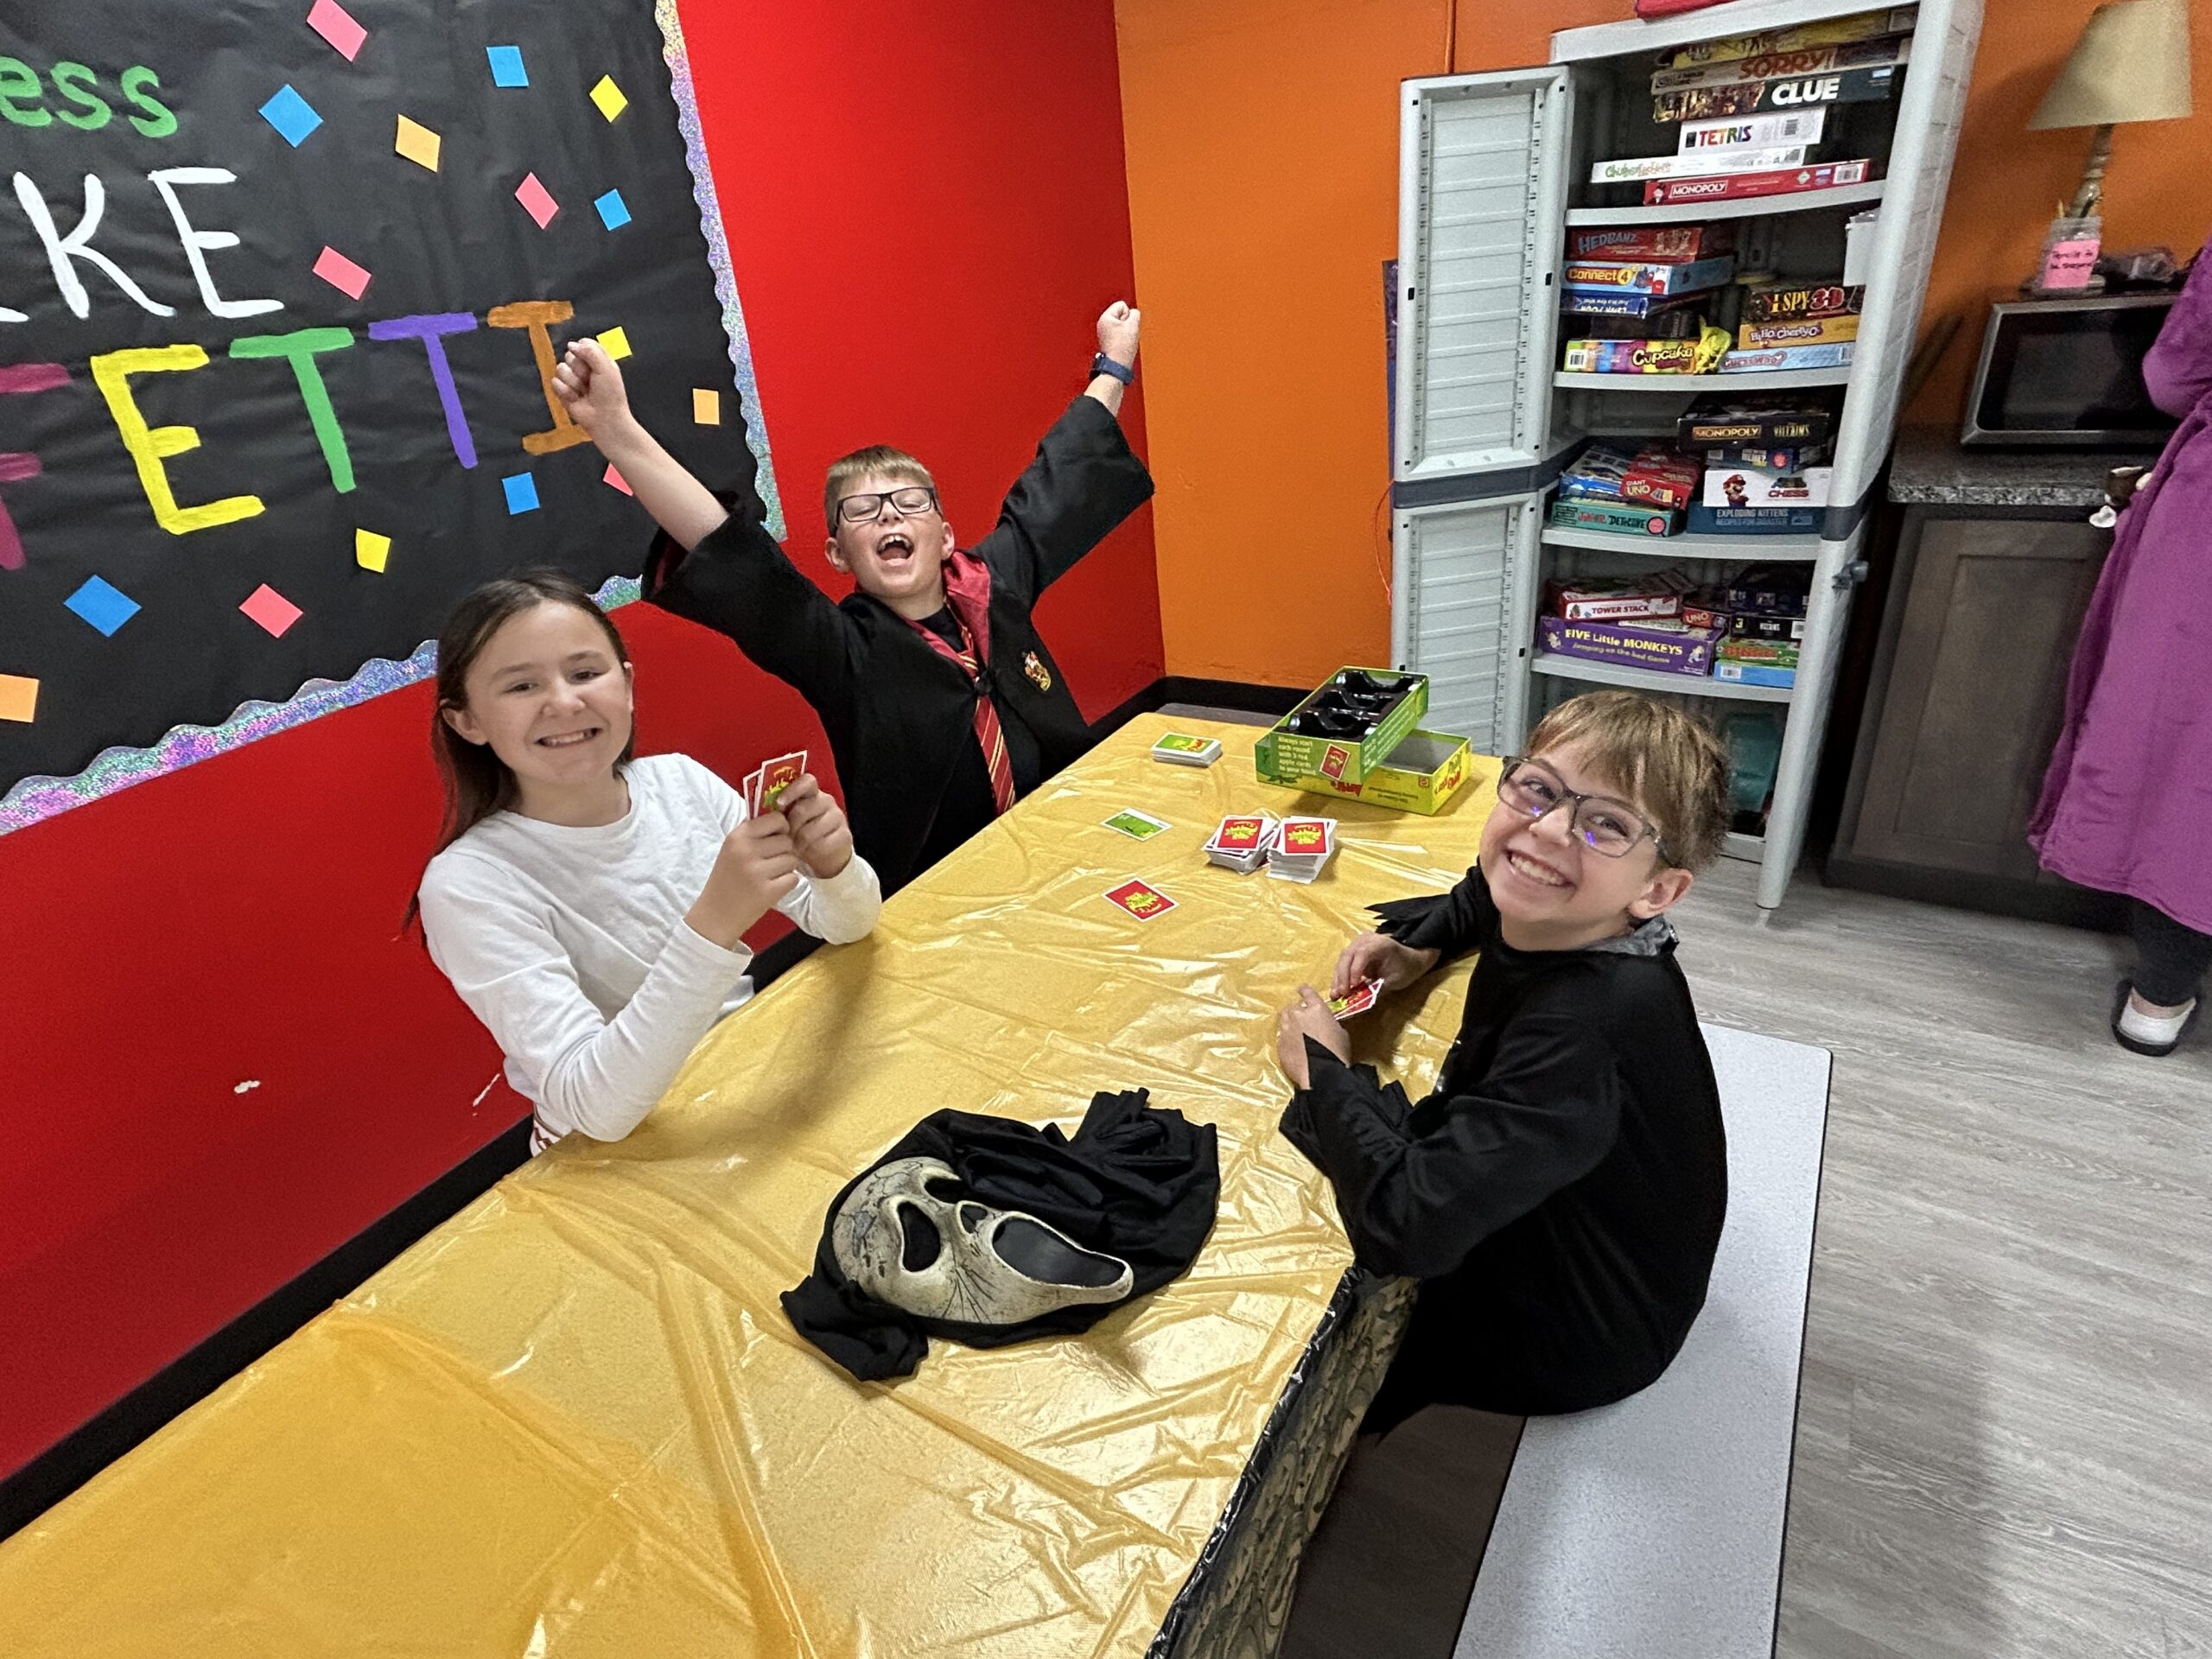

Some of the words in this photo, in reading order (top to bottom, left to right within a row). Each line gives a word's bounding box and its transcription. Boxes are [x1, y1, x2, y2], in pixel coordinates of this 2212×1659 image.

[1738, 48, 1834, 79] SORRY!
[1771, 77, 1840, 105] CLUE
[1699, 124, 1753, 146] TETRIS
[1672, 182, 1726, 196] MONOPOLY
[0, 167, 283, 321] KE
[1578, 232, 1638, 255] HEDBANZ
[1568, 269, 1617, 282] Connect
[1619, 270, 1630, 283] 4
[1770, 294, 1780, 313] I
[1783, 290, 1811, 312] SPY
[1632, 346, 1694, 365] Cupcake
[1695, 427, 1758, 437] MONOPOLY
[1625, 485, 1650, 497] UNO
[1768, 489, 1809, 499] CHESS
[1717, 509, 1756, 518] EXPLODING
[1686, 612, 1709, 623] UNO
[1565, 629, 1592, 641] FIVE
[1592, 632, 1620, 646] Little
[1624, 638, 1683, 655] MONKEYS
[1573, 642, 1604, 654] Jumping
